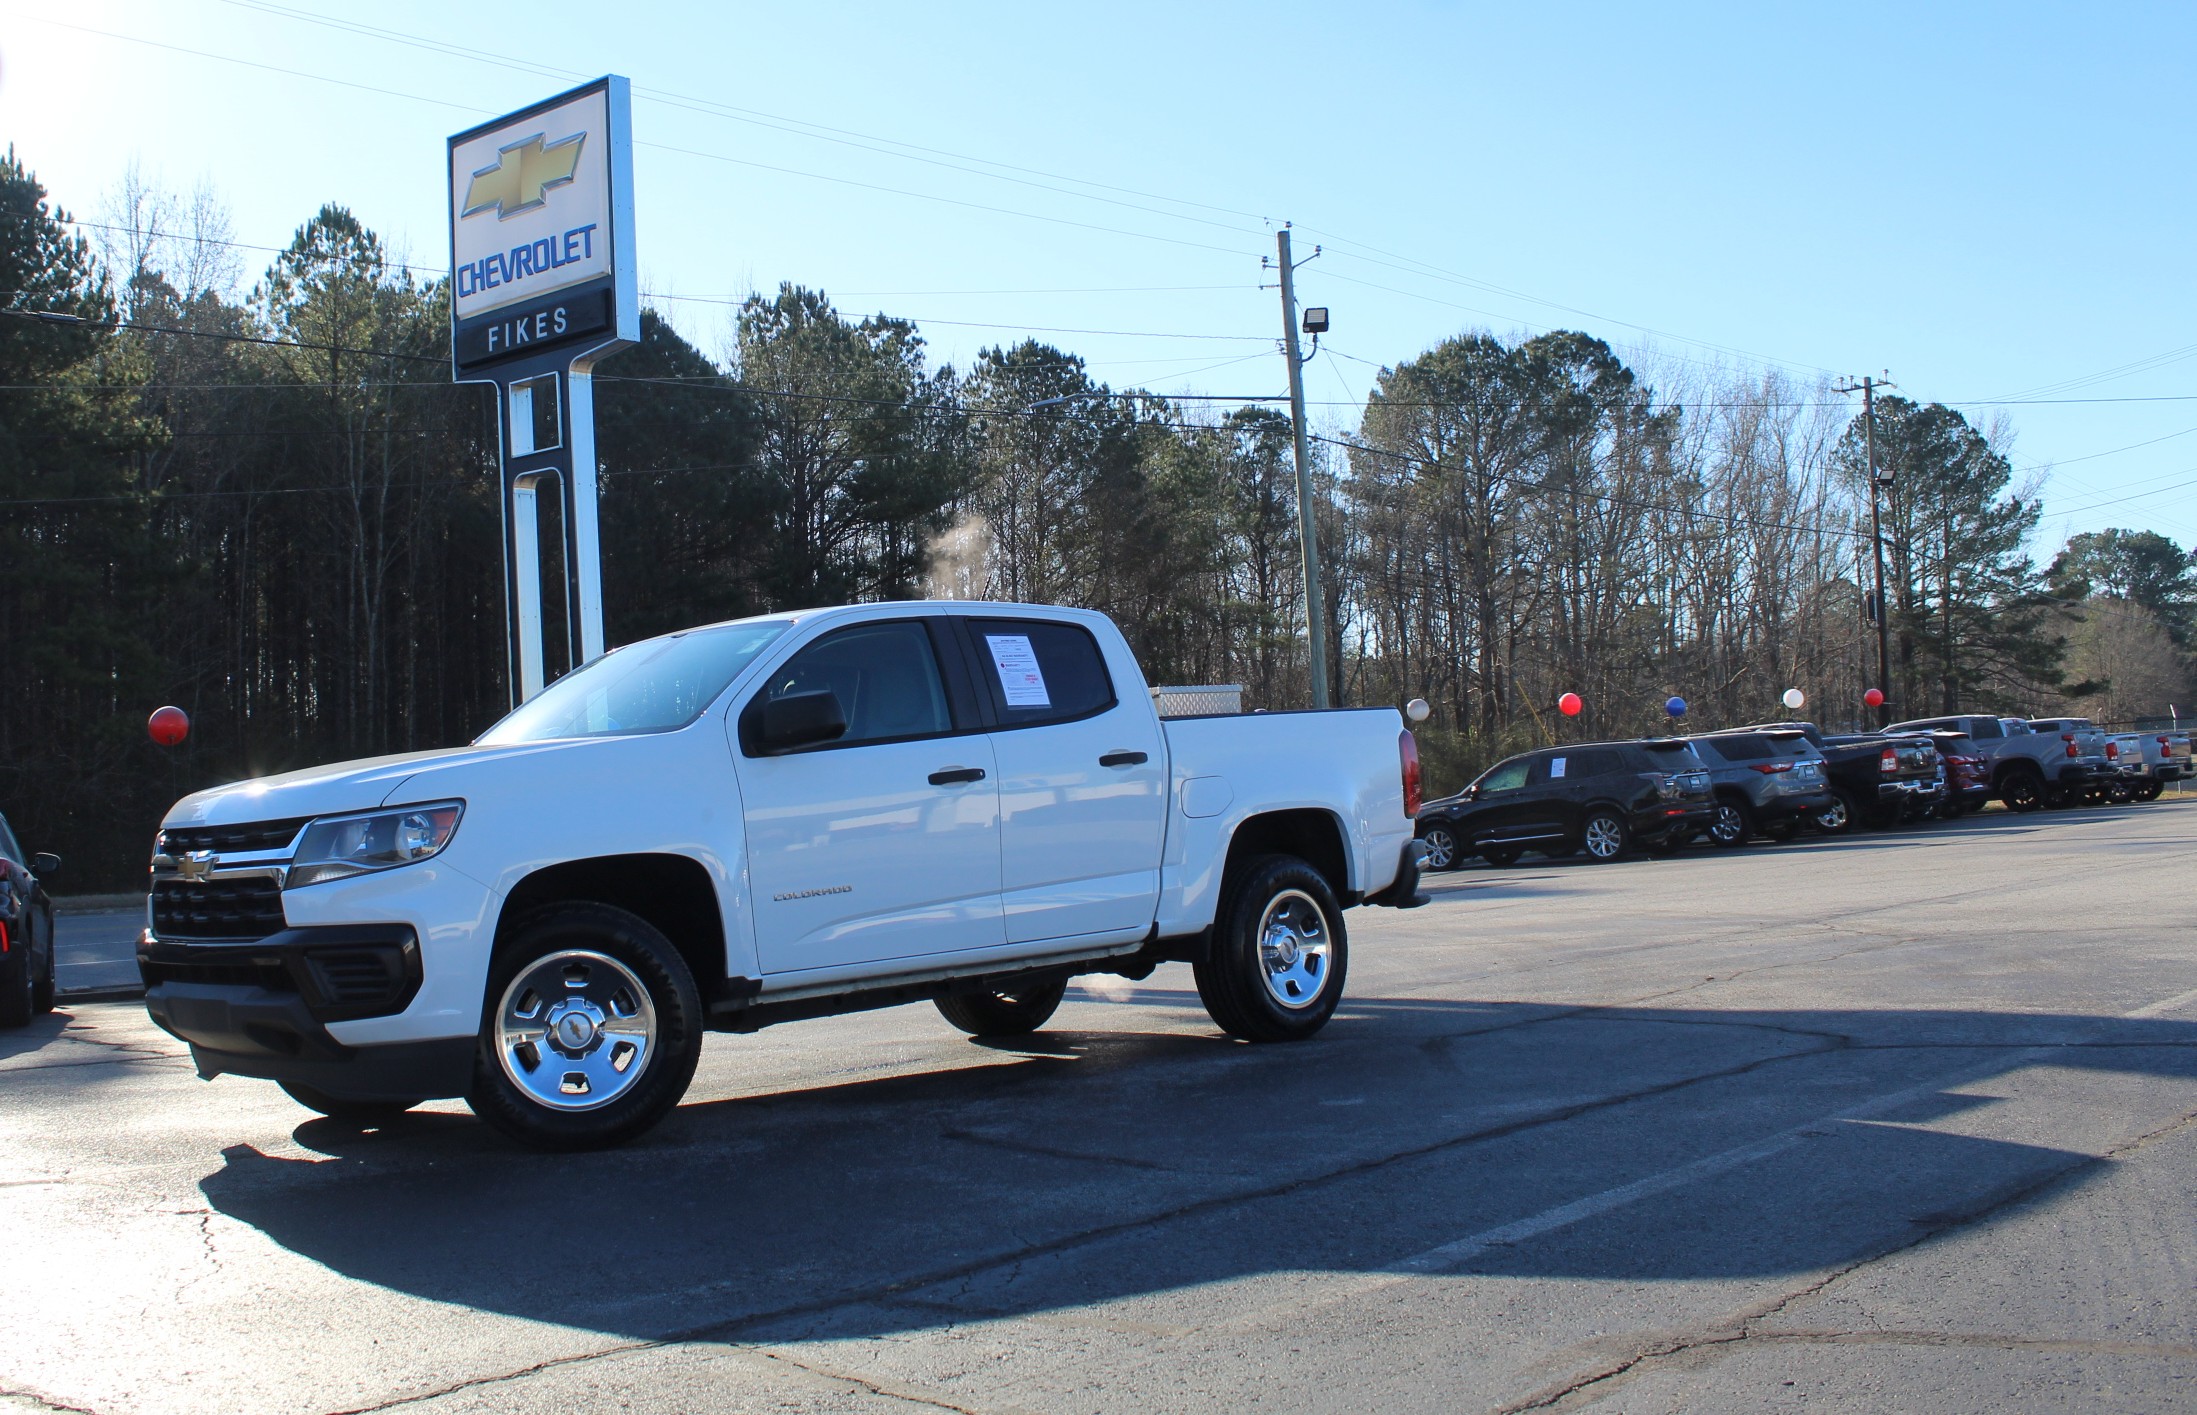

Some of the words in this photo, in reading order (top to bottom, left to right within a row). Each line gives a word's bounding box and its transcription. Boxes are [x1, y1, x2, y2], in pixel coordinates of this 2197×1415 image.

[457, 223, 597, 298] CHEVROLET
[488, 307, 567, 352] FIKES
[773, 885, 853, 902] COLORADO
